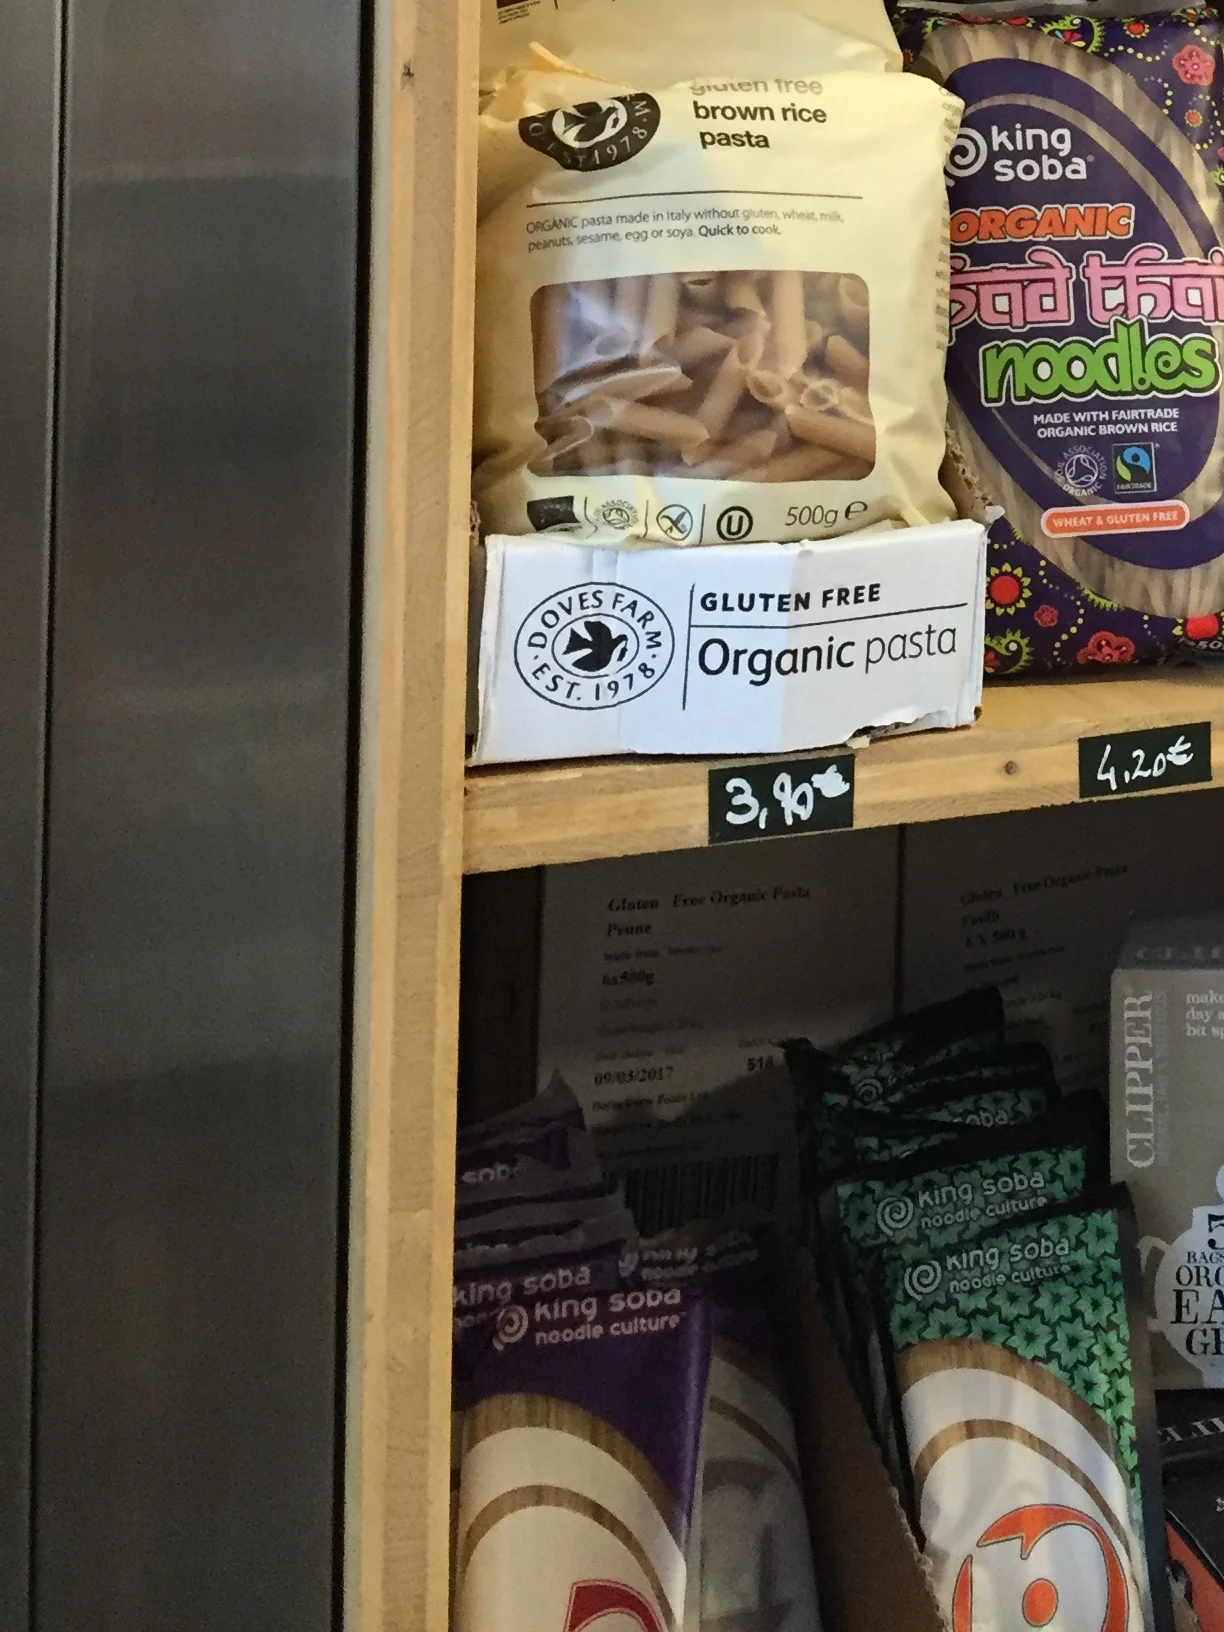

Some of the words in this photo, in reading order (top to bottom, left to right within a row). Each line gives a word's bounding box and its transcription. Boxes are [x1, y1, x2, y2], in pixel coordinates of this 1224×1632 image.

[692, 99, 776, 123] brown
[780, 103, 828, 125] rice
[593, 125, 649, 166] 1978
[699, 128, 771, 150] pasta
[990, 124, 1072, 153] king
[993, 154, 1089, 182] soba
[526, 213, 579, 235] ORGANIC
[580, 210, 614, 230] pasta
[615, 208, 650, 225] made
[652, 207, 664, 223] in
[666, 206, 692, 224] Italy
[693, 205, 741, 222] without
[624, 227, 649, 243] egg
[651, 227, 664, 239] or
[698, 222, 734, 239] Quick
[736, 223, 750, 236] to
[951, 205, 1133, 243] ORGANIC
[982, 320, 1220, 404] noodles
[1033, 410, 1070, 425] MADE
[1073, 409, 1110, 424] WITH
[1111, 407, 1180, 423] FAIRTRADE
[1037, 423, 1097, 438] ORGANIC
[1098, 421, 1149, 436] BROWN
[1151, 420, 1178, 434] RICE
[783, 504, 838, 528] 500g
[1052, 515, 1093, 529] WHEAT
[1096, 515, 1103, 526] &
[1105, 512, 1151, 527] GLUTEN
[1153, 510, 1179, 523] FREE
[700, 591, 811, 613] GLUTEN
[821, 583, 881, 609] FREE
[527, 589, 604, 649] DOVES
[612, 591, 663, 649] FARM
[698, 636, 856, 687] Organic
[865, 623, 957, 675] pasta
[531, 663, 583, 702] EST.
[594, 662, 656, 701] 1978
[672, 892, 705, 908] Free
[709, 888, 767, 908] Organic
[1186, 1006, 1214, 1022] day
[1186, 1023, 1208, 1037] bit
[1123, 992, 1156, 1168] CLIPPER
[918, 1181, 974, 1209] king
[982, 1170, 1046, 1197] soba
[920, 1206, 981, 1230] noodle
[985, 1194, 1048, 1217] culture
[946, 1245, 1001, 1272] king
[1009, 1236, 1070, 1263] soba
[523, 1264, 591, 1296] soba
[949, 1271, 1006, 1295] noodle
[1010, 1262, 1071, 1284] culture
[534, 1292, 598, 1323] king
[608, 1285, 682, 1313] soba
[535, 1321, 604, 1346] noodle
[609, 1312, 681, 1338] culture
